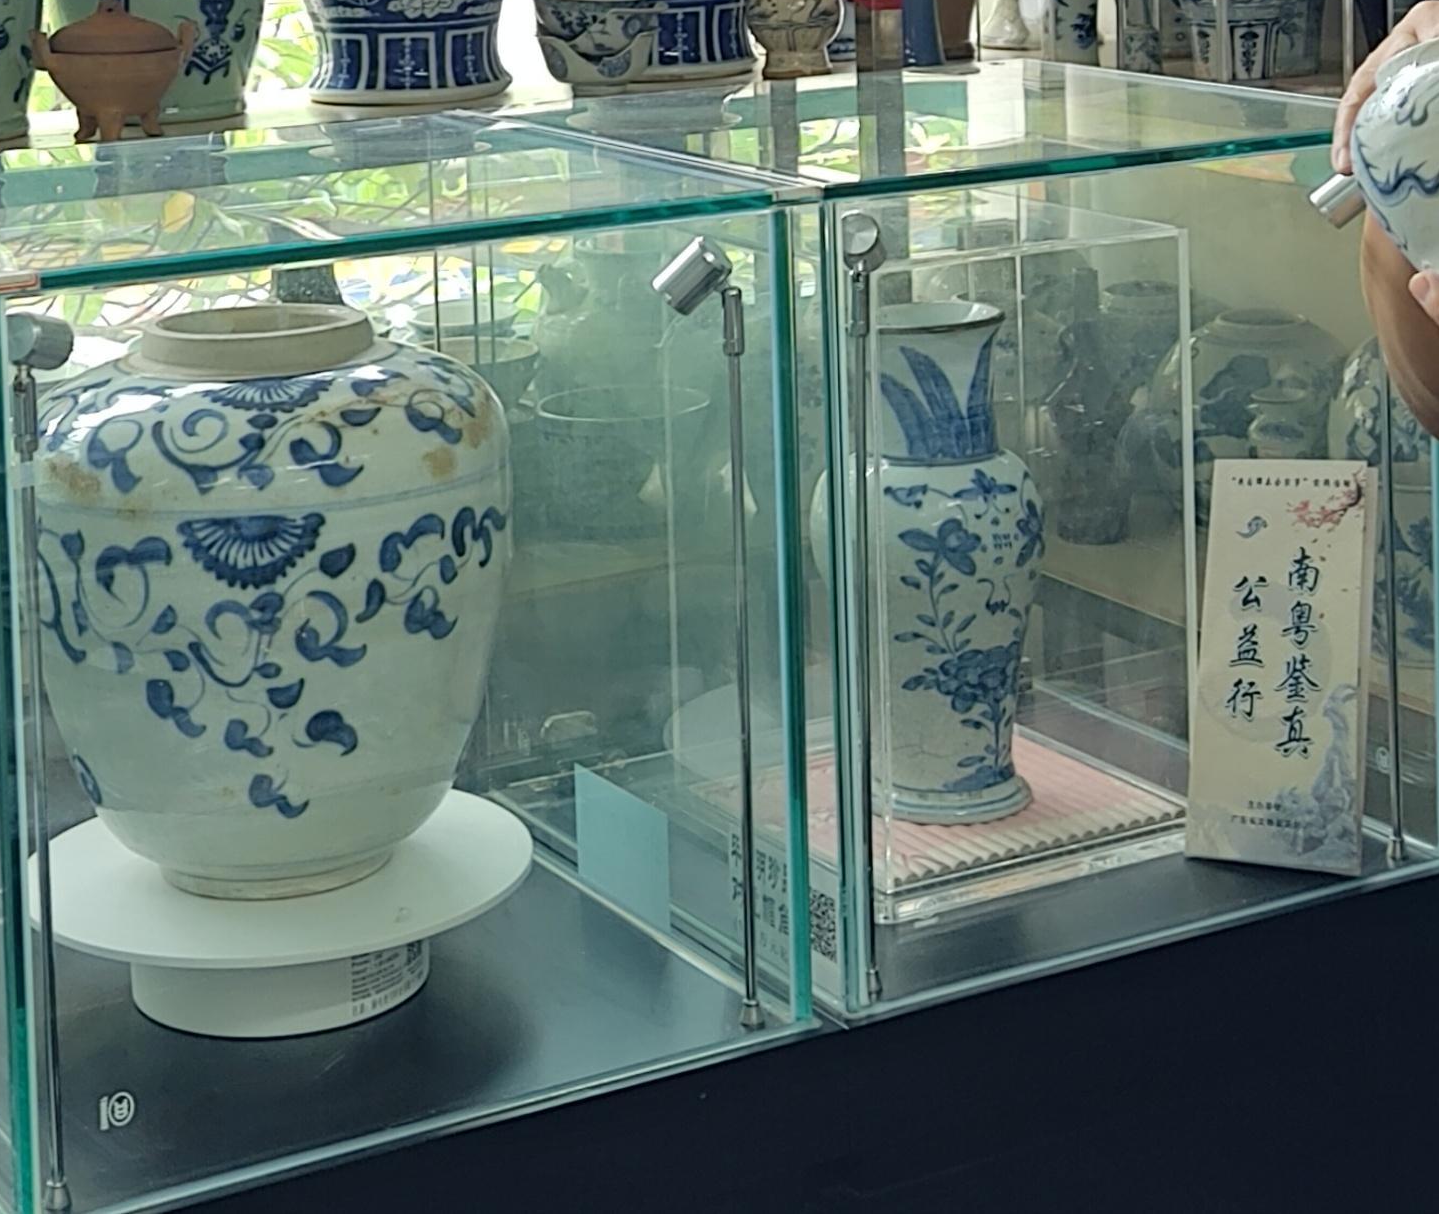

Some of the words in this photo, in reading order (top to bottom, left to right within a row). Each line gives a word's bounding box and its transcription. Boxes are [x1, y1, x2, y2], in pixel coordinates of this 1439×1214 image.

[1227, 575, 1268, 718] 公益行
[1278, 546, 1321, 755] 南粤鉴真
